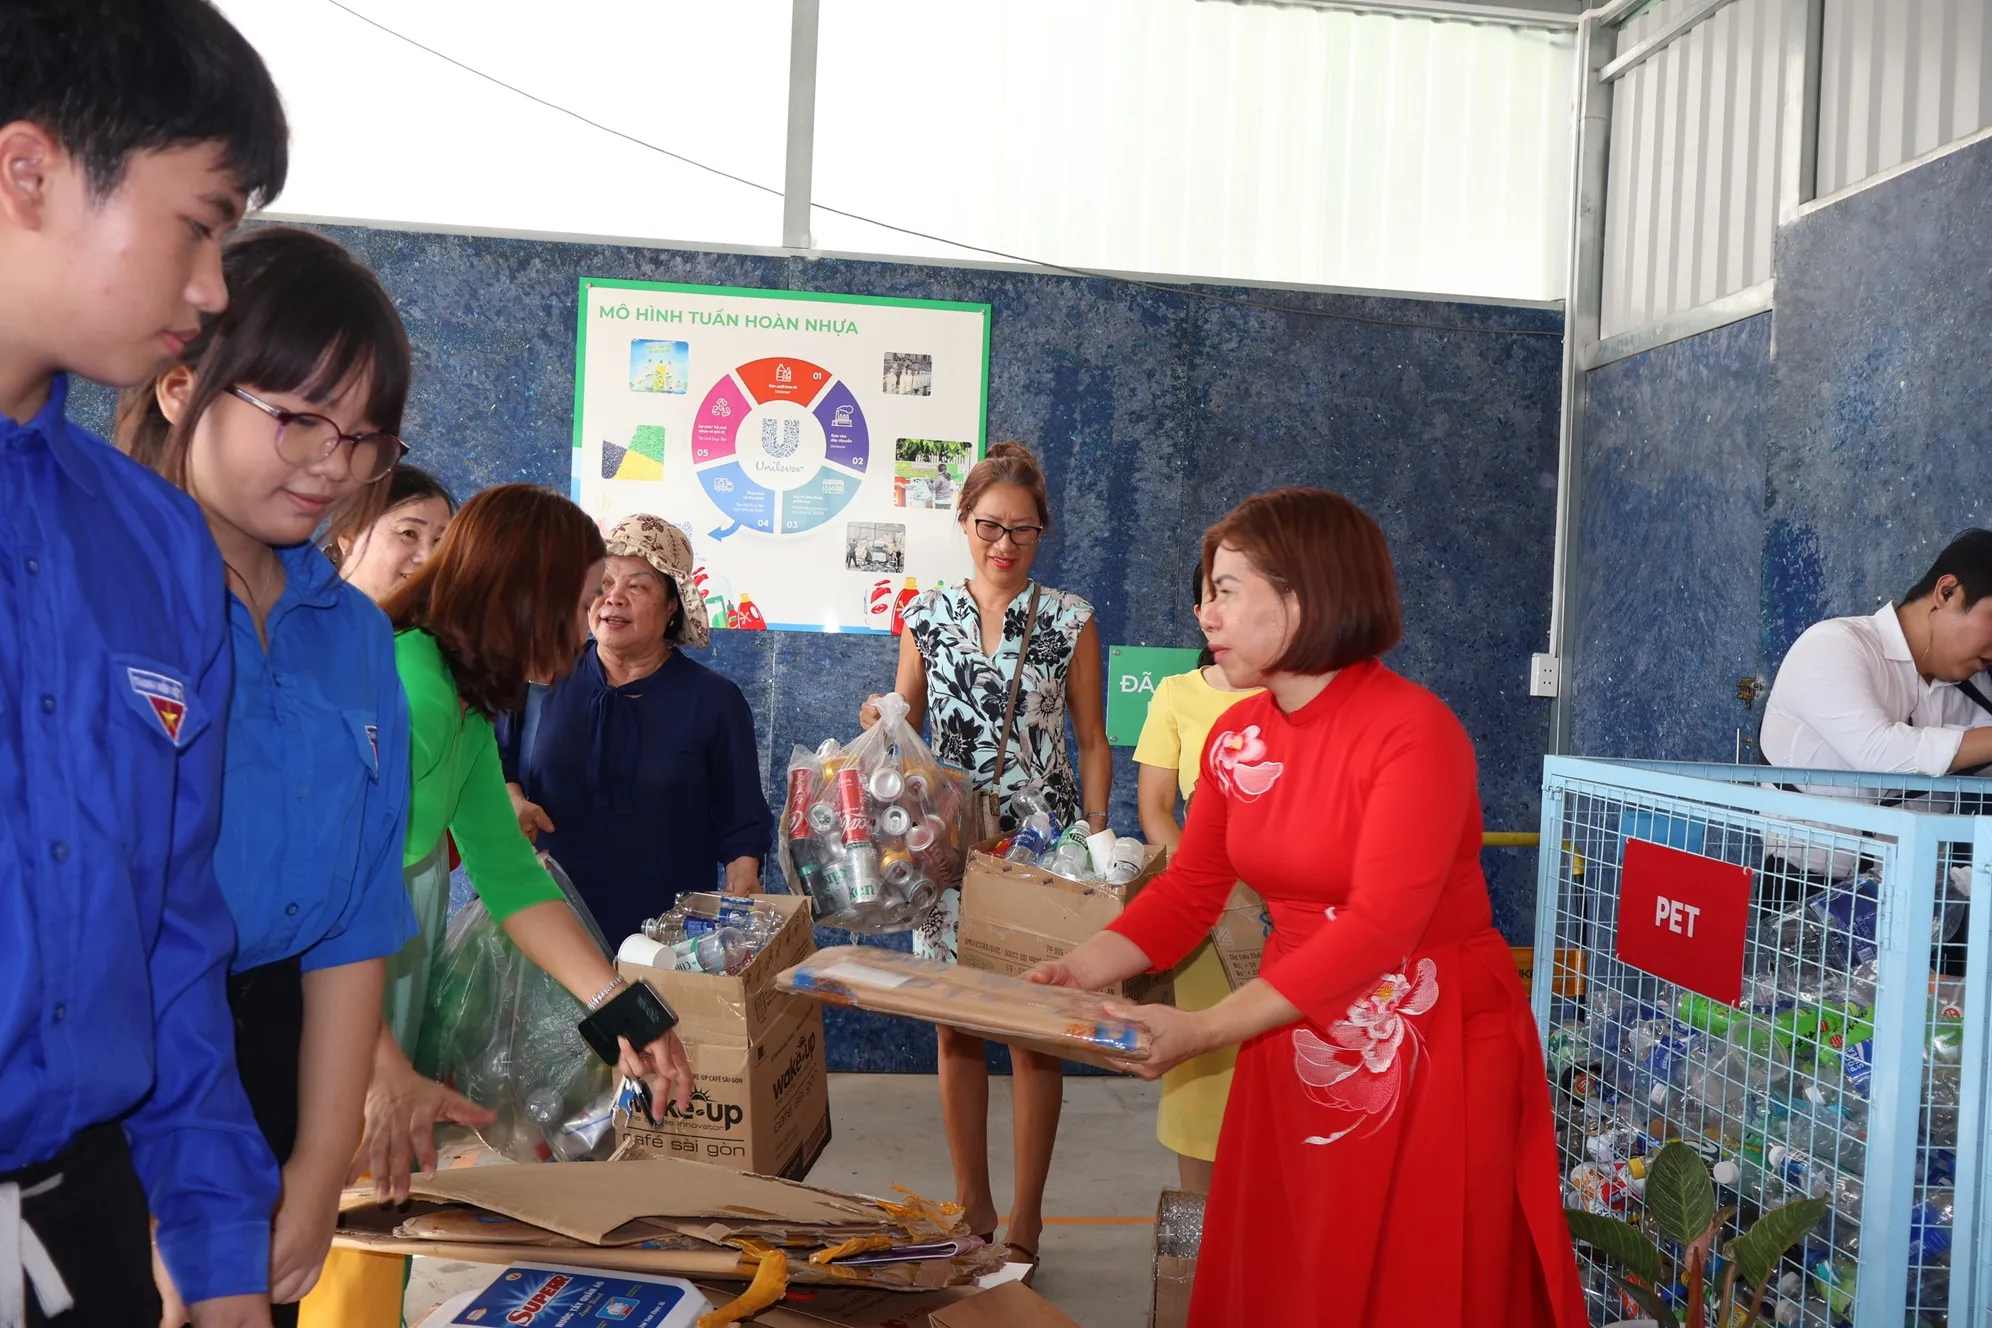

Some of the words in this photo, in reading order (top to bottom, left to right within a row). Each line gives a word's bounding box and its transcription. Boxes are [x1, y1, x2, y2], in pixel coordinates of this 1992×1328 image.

[599, 303, 630, 320] MÔ
[636, 306, 683, 323] HÌNH
[688, 308, 739, 327] TUẦN
[745, 313, 799, 331] HOÀN
[805, 317, 859, 336] NHỰA
[813, 372, 822, 380] 01
[697, 449, 708, 457] 05
[852, 457, 864, 465] 02
[755, 461, 804, 473] Unilever
[757, 519, 769, 527] 04
[786, 520, 798, 529] 03
[1120, 671, 1155, 693] ĐÃ
[1655, 896, 1700, 938] PET
[677, 1121, 724, 1131] innovator
[671, 1138, 699, 1153] sài
[706, 1141, 746, 1157] gòn
